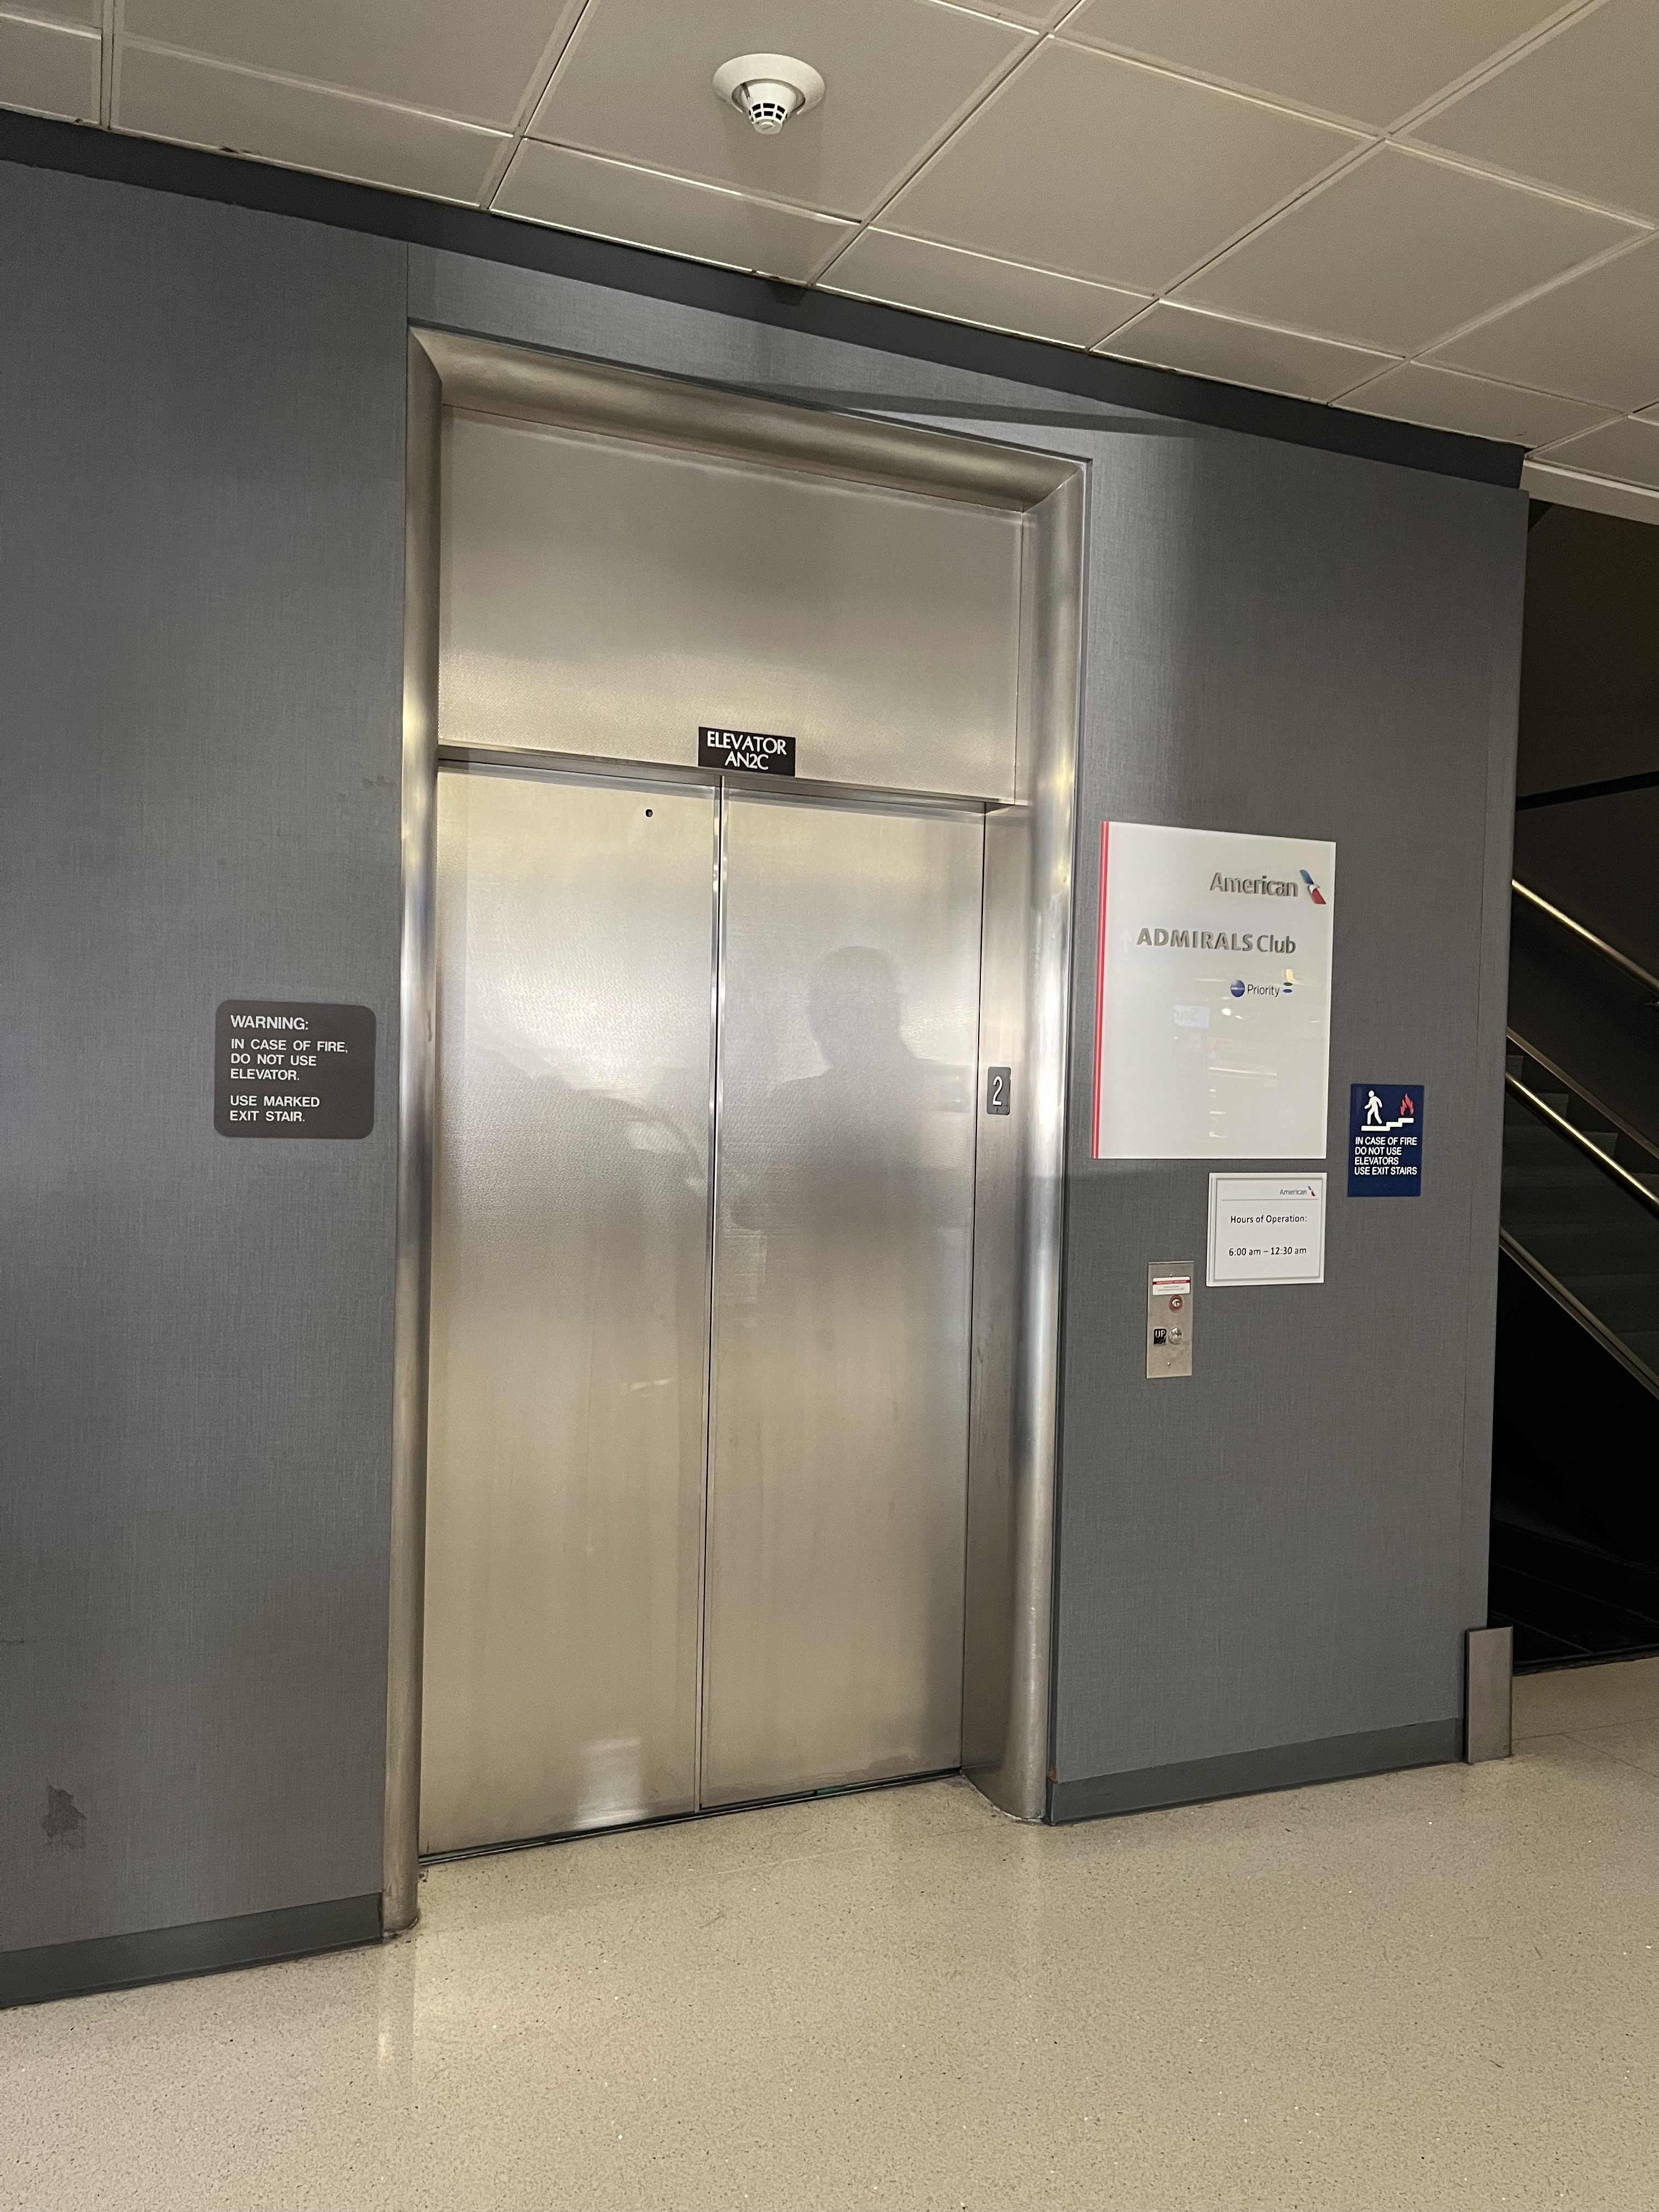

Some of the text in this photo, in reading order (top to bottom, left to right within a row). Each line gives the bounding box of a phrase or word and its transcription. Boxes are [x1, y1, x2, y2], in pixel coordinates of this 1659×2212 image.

[707, 731, 787, 755] ELEVATOR
[725, 751, 769, 770] AN2C
[1209, 872, 1298, 896] American
[1136, 928, 1296, 953] ADMIRALS Club
[1247, 984, 1280, 997] Priority
[230, 1015, 308, 1030] WARNING:
[231, 1039, 348, 1053] IN CASE OF FIRE,
[230, 1053, 317, 1066] DO NOT USE
[230, 1068, 300, 1080] ELEVATOR.
[992, 1076, 1003, 1105] 2
[230, 1095, 320, 1107] USE MARKED
[230, 1110, 305, 1121] EXIT STAIR.
[1355, 1137, 1418, 1146] IN CASE OF FIRE
[1355, 1147, 1402, 1155] DO NOT USE
[1355, 1156, 1399, 1165] ELEVATORS
[1355, 1166, 1418, 1175] USE EXIT STAIRS
[1231, 1214, 1307, 1224] Hours of Operation:
[1229, 1248, 1246, 1256] 6:00
[1271, 1246, 1293, 1255] 12:30
[1155, 1330, 1166, 1338] UP
